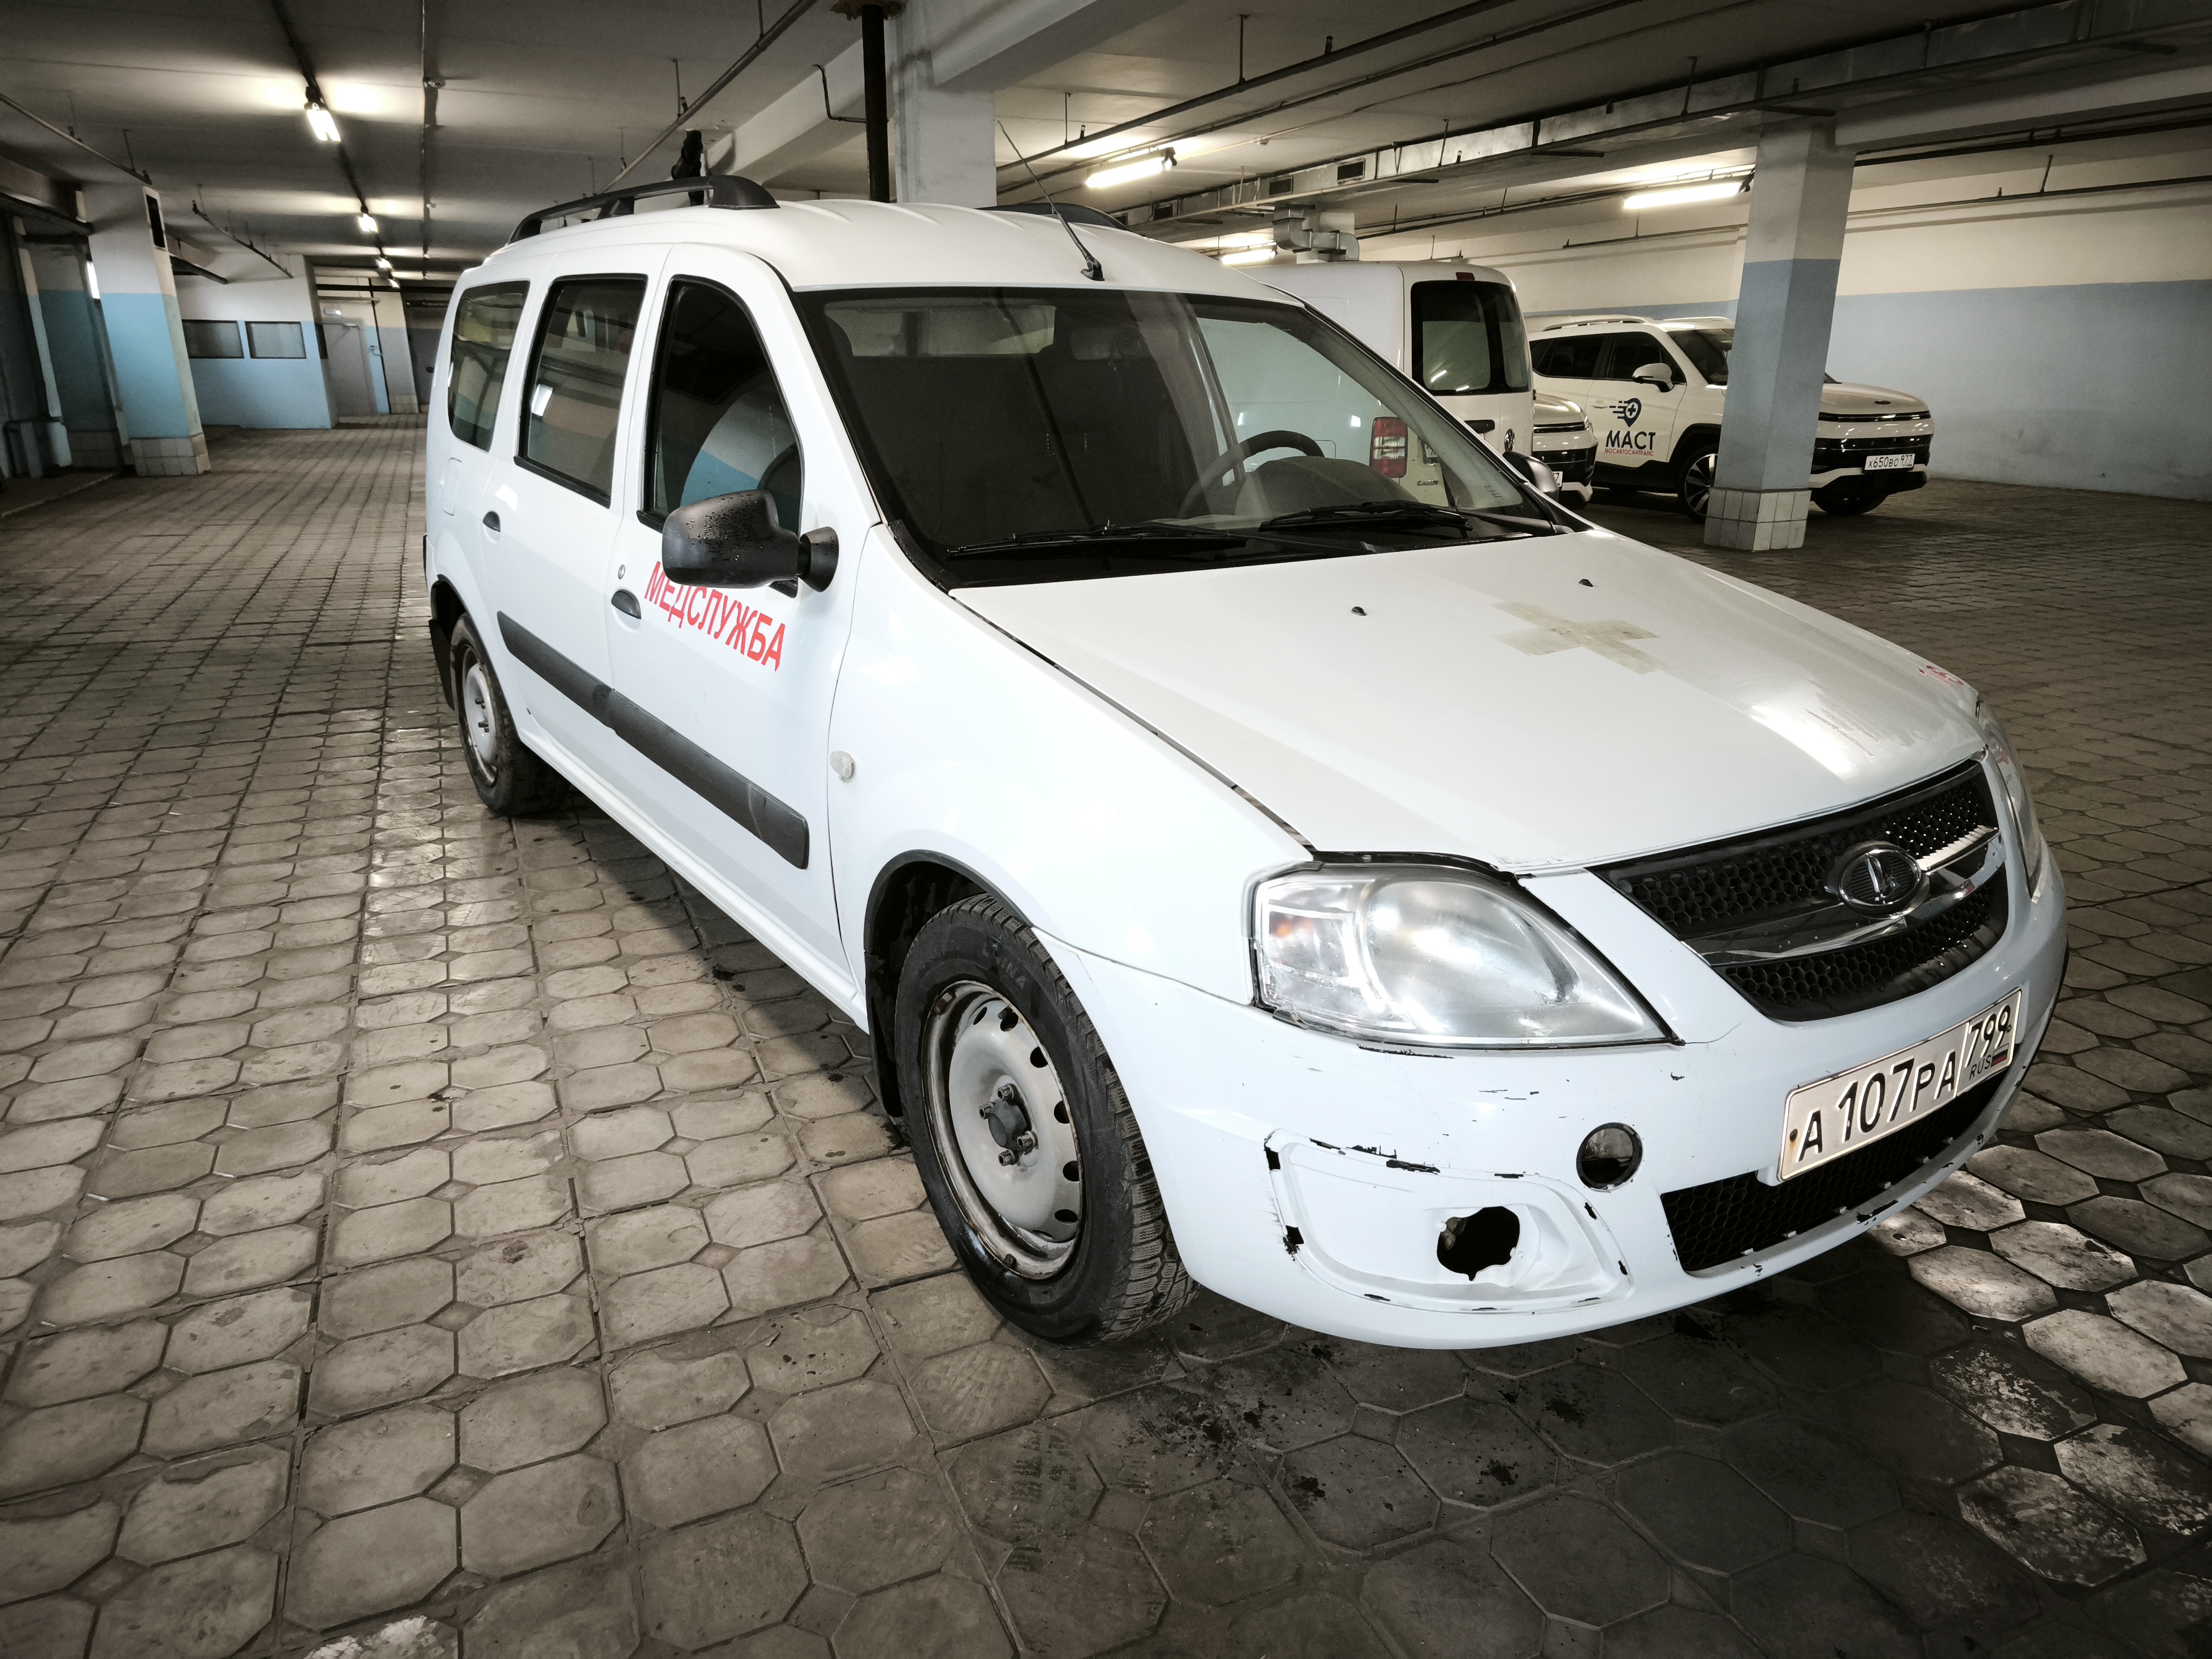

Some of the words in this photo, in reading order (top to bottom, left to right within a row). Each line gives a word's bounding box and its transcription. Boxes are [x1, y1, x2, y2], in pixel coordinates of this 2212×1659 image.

[1606, 430, 1656, 450] МАСТ
[644, 561, 785, 672] МЕДСЛУЖБА
[1965, 1004, 2011, 1068] 799
[1969, 1055, 1991, 1081] RUS
